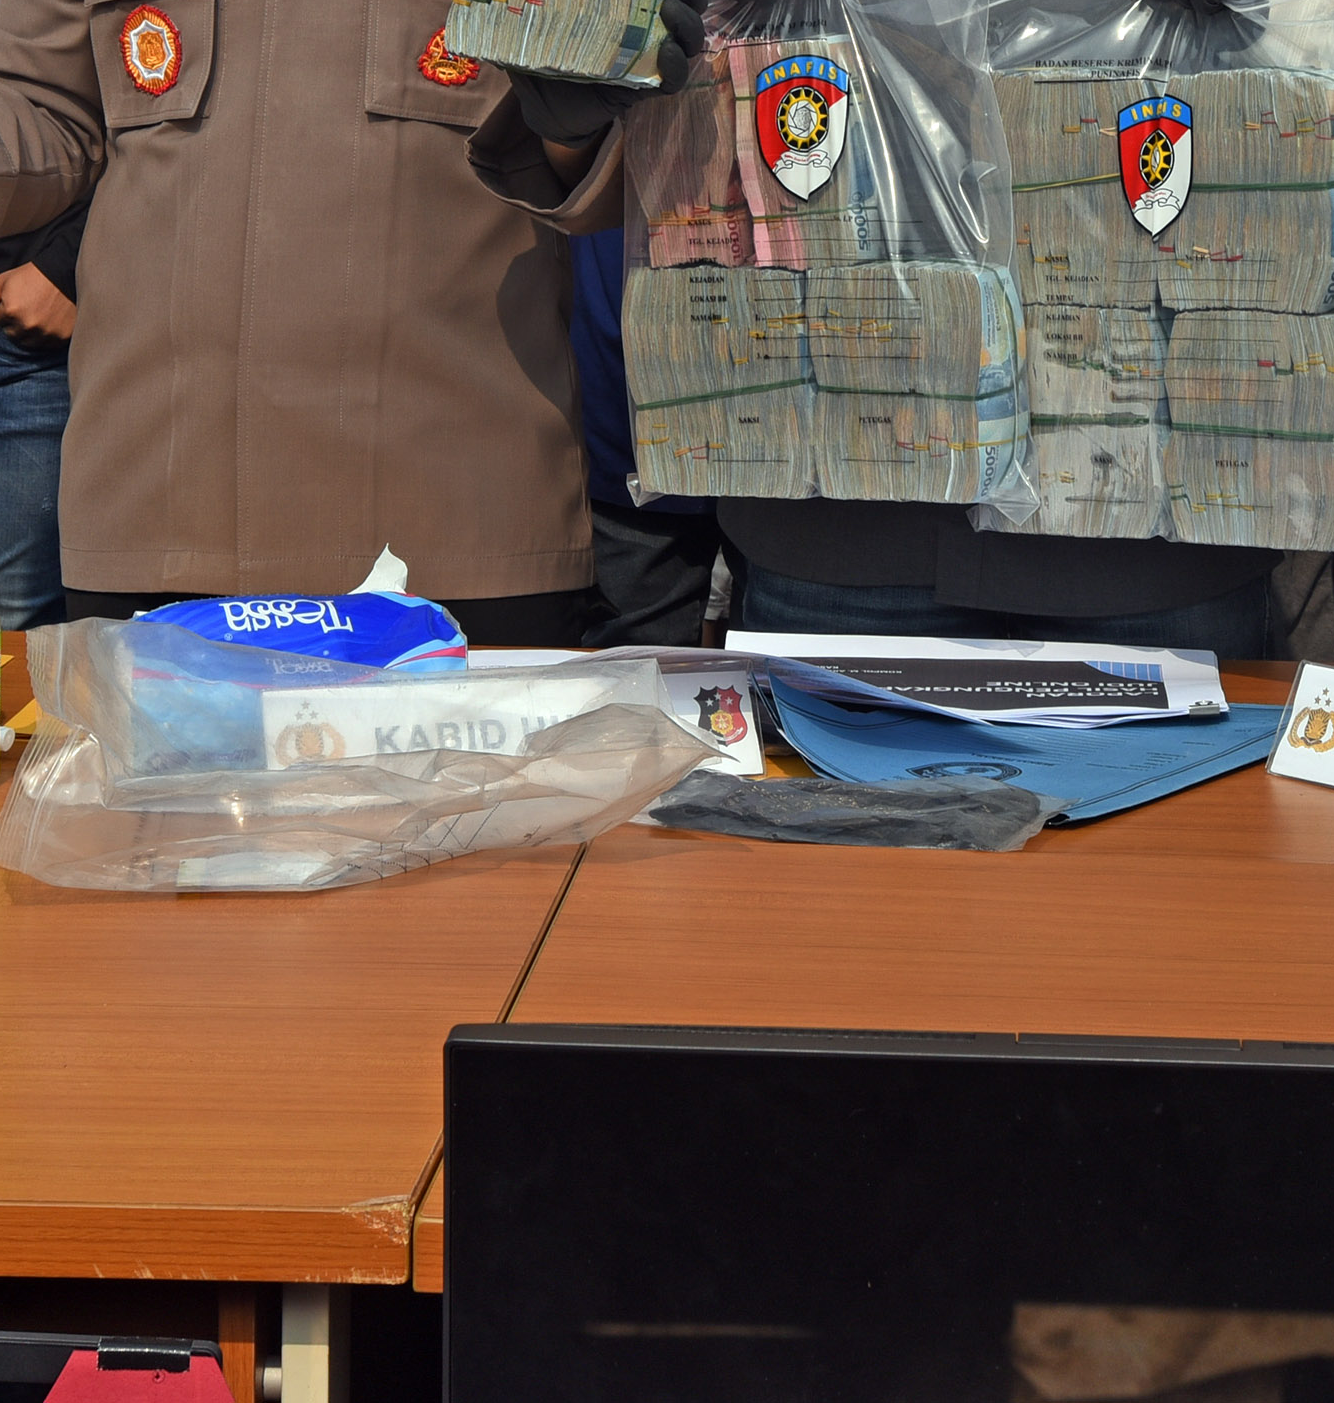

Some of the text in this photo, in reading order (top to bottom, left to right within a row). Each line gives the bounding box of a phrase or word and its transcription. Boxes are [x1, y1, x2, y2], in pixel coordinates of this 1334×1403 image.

[763, 59, 839, 85] INAFIS
[1034, 59, 1069, 69] BADAN
[1071, 59, 1115, 68] RESERSE
[689, 276, 726, 285] KEJADIAN
[218, 598, 355, 635] Tessa
[374, 718, 507, 754] KABID
